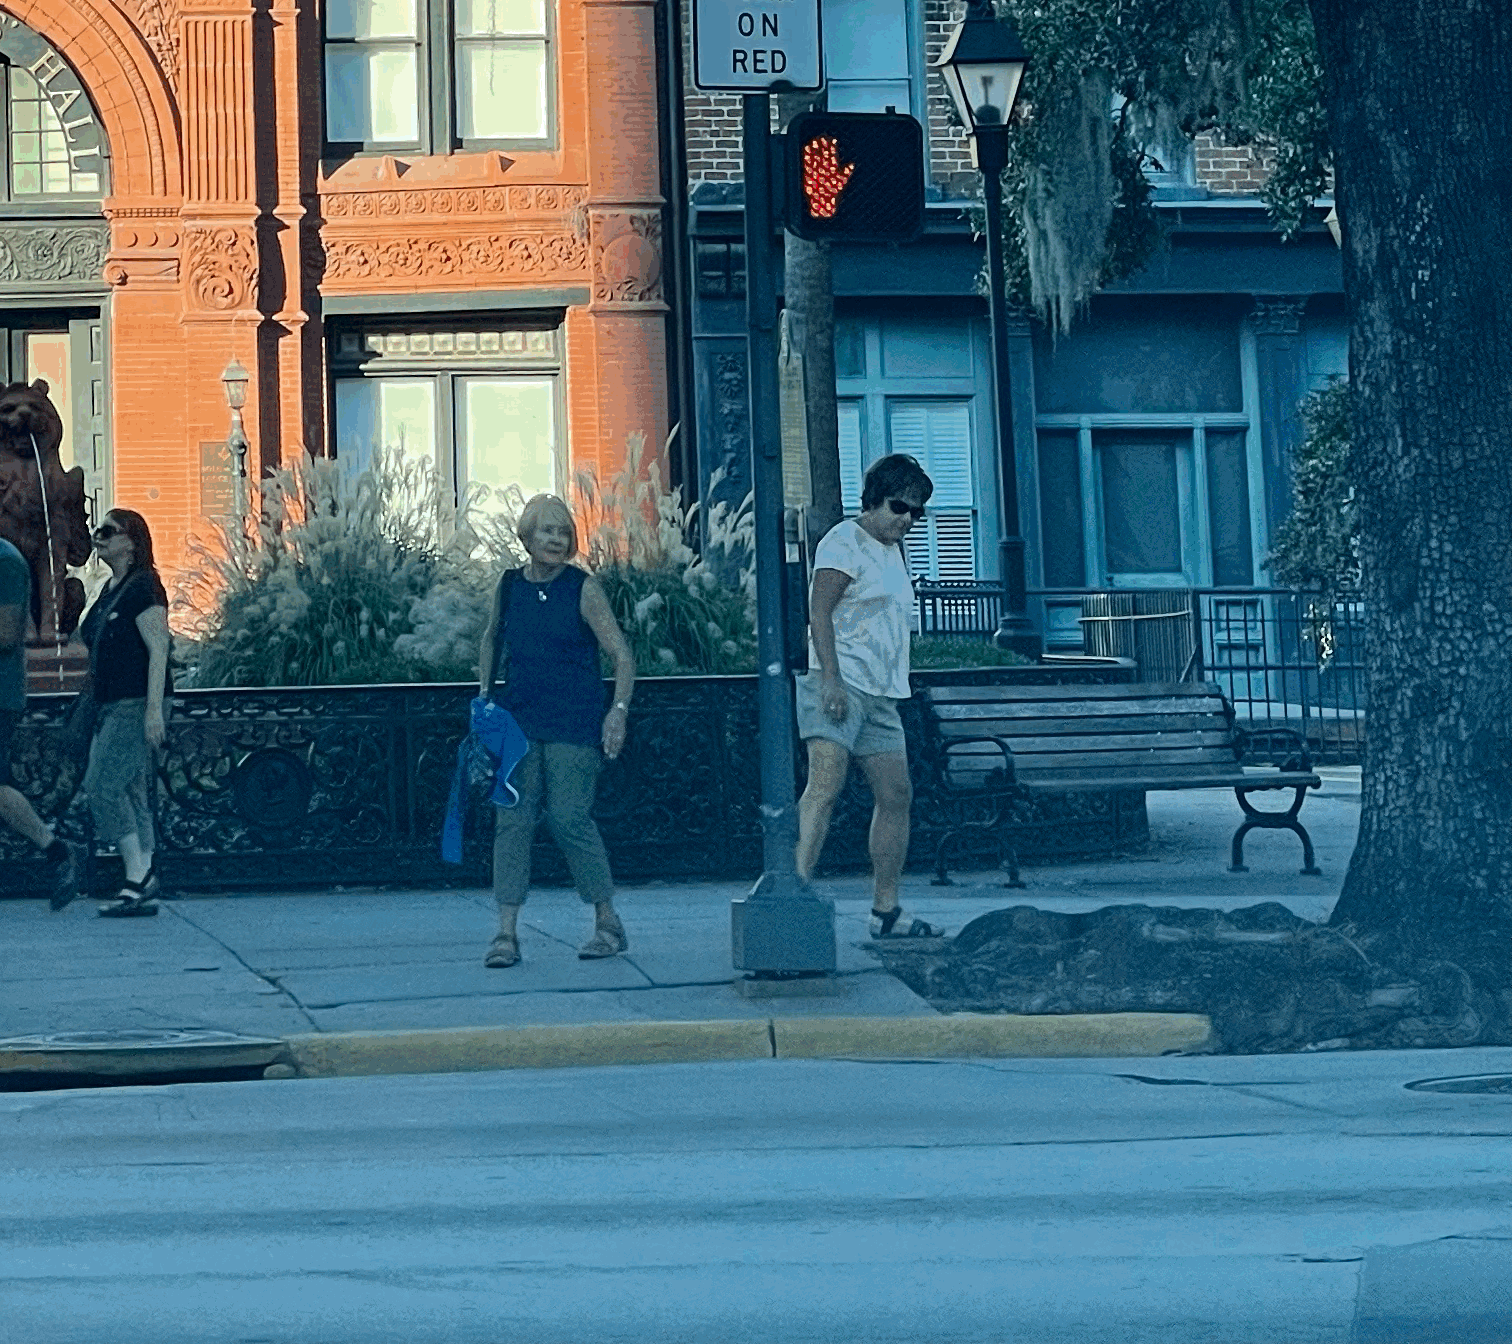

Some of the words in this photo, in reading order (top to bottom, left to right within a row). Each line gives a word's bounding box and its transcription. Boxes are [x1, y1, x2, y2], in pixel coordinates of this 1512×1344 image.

[737, 12, 779, 37] ON
[732, 48, 787, 74] RED
[28, 47, 101, 173] HALL
